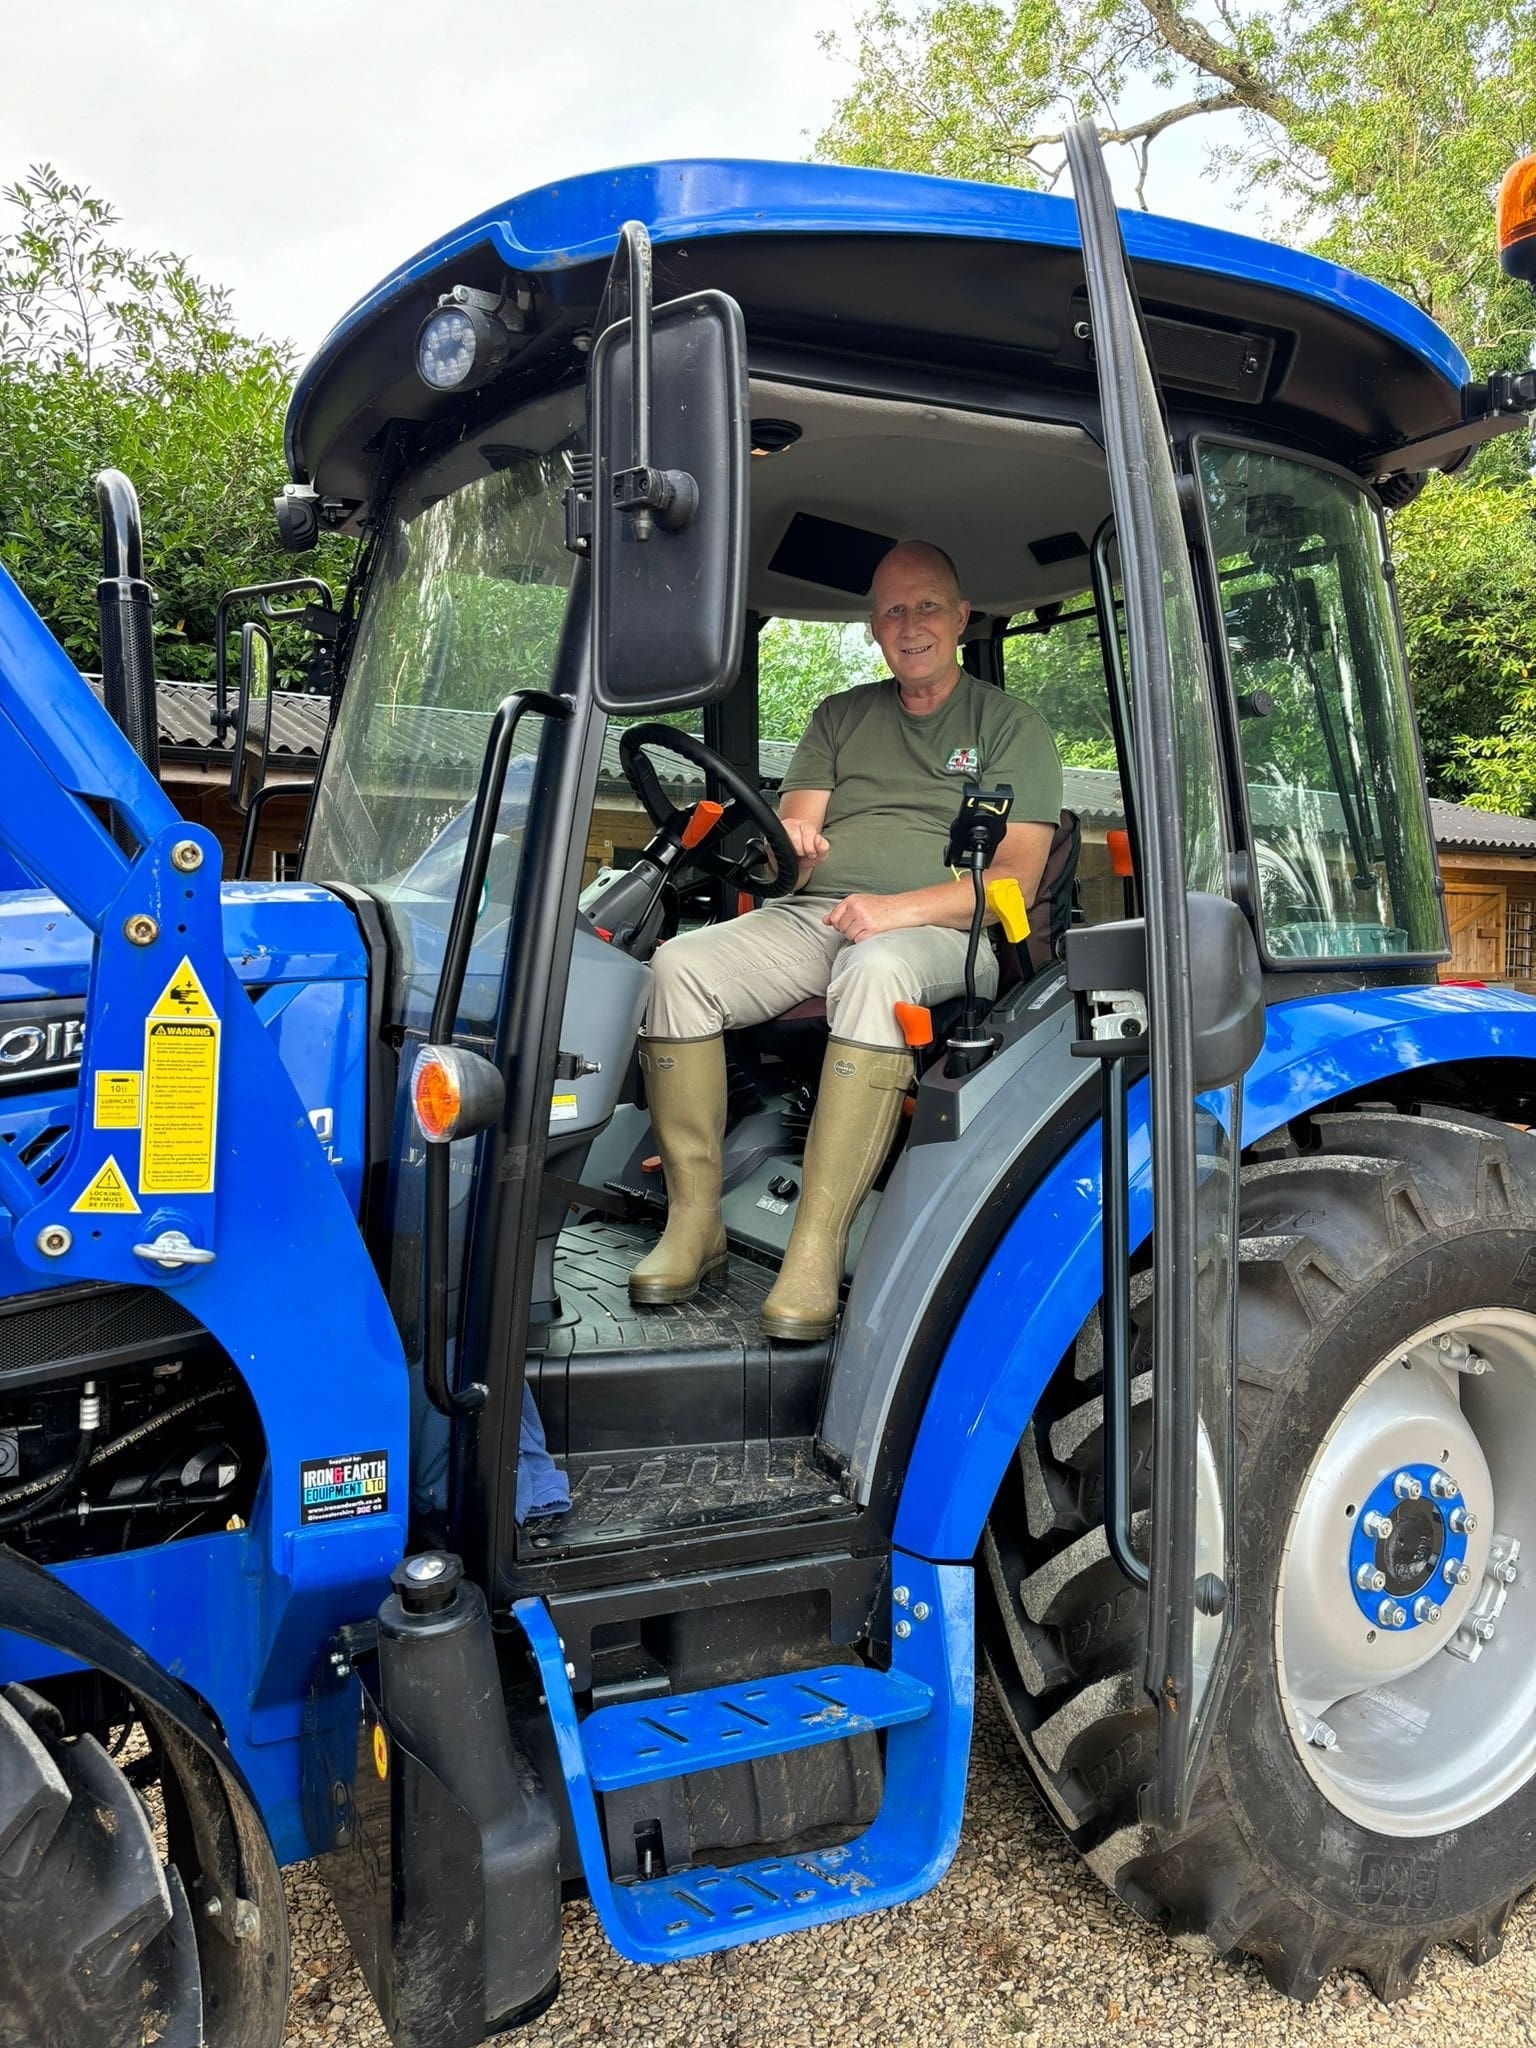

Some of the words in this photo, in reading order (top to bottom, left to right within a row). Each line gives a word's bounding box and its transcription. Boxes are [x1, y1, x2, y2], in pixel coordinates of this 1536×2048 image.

[166, 1027, 211, 1036] WARNING
[147, 1413, 172, 1431] HEATER
[129, 1428, 147, 1443] HOSE
[306, 1481, 362, 1502] EQUIPMENT
[364, 1478, 384, 1493] LTD
